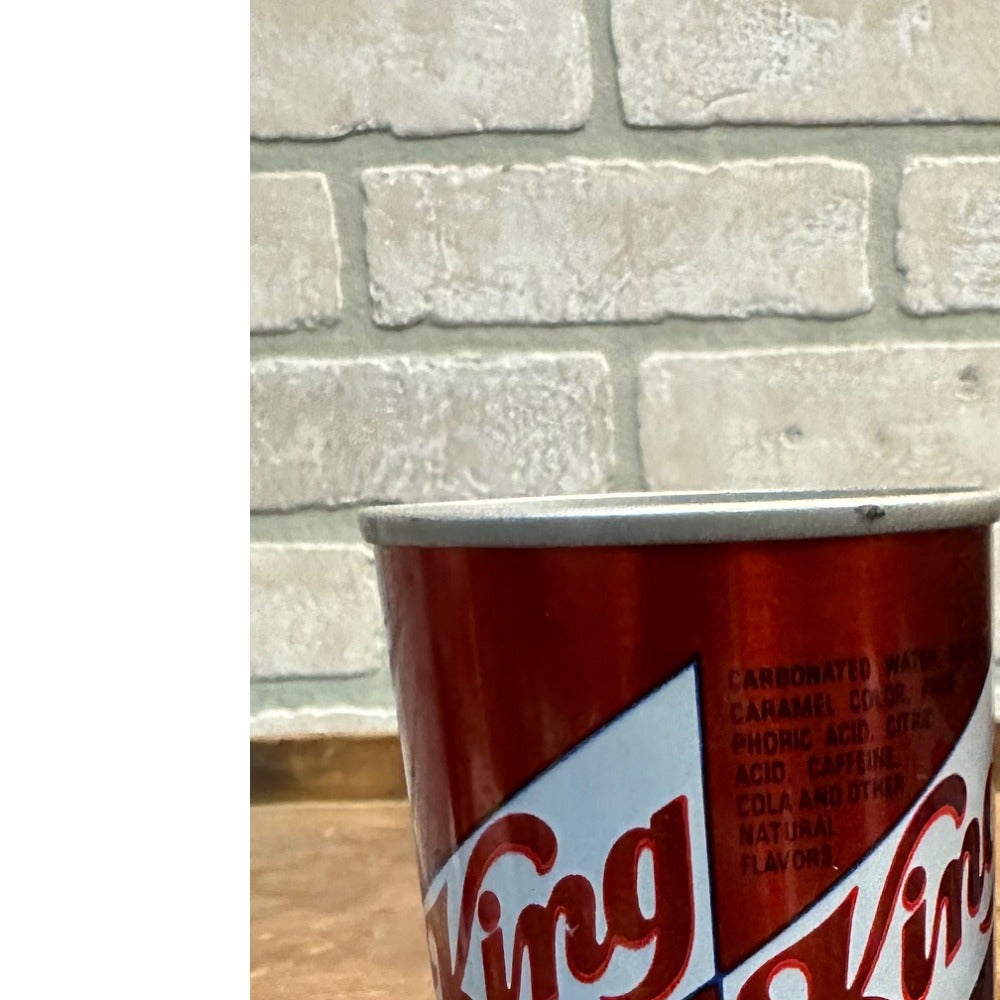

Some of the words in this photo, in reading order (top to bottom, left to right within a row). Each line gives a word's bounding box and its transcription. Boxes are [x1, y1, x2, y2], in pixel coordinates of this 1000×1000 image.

[728, 656, 871, 690] CARBONATED
[730, 692, 836, 725] CARAMEL
[732, 727, 812, 755] PHORIC
[736, 791, 792, 818] COLA
[799, 783, 842, 809] AND
[739, 816, 837, 847] NATURAL
